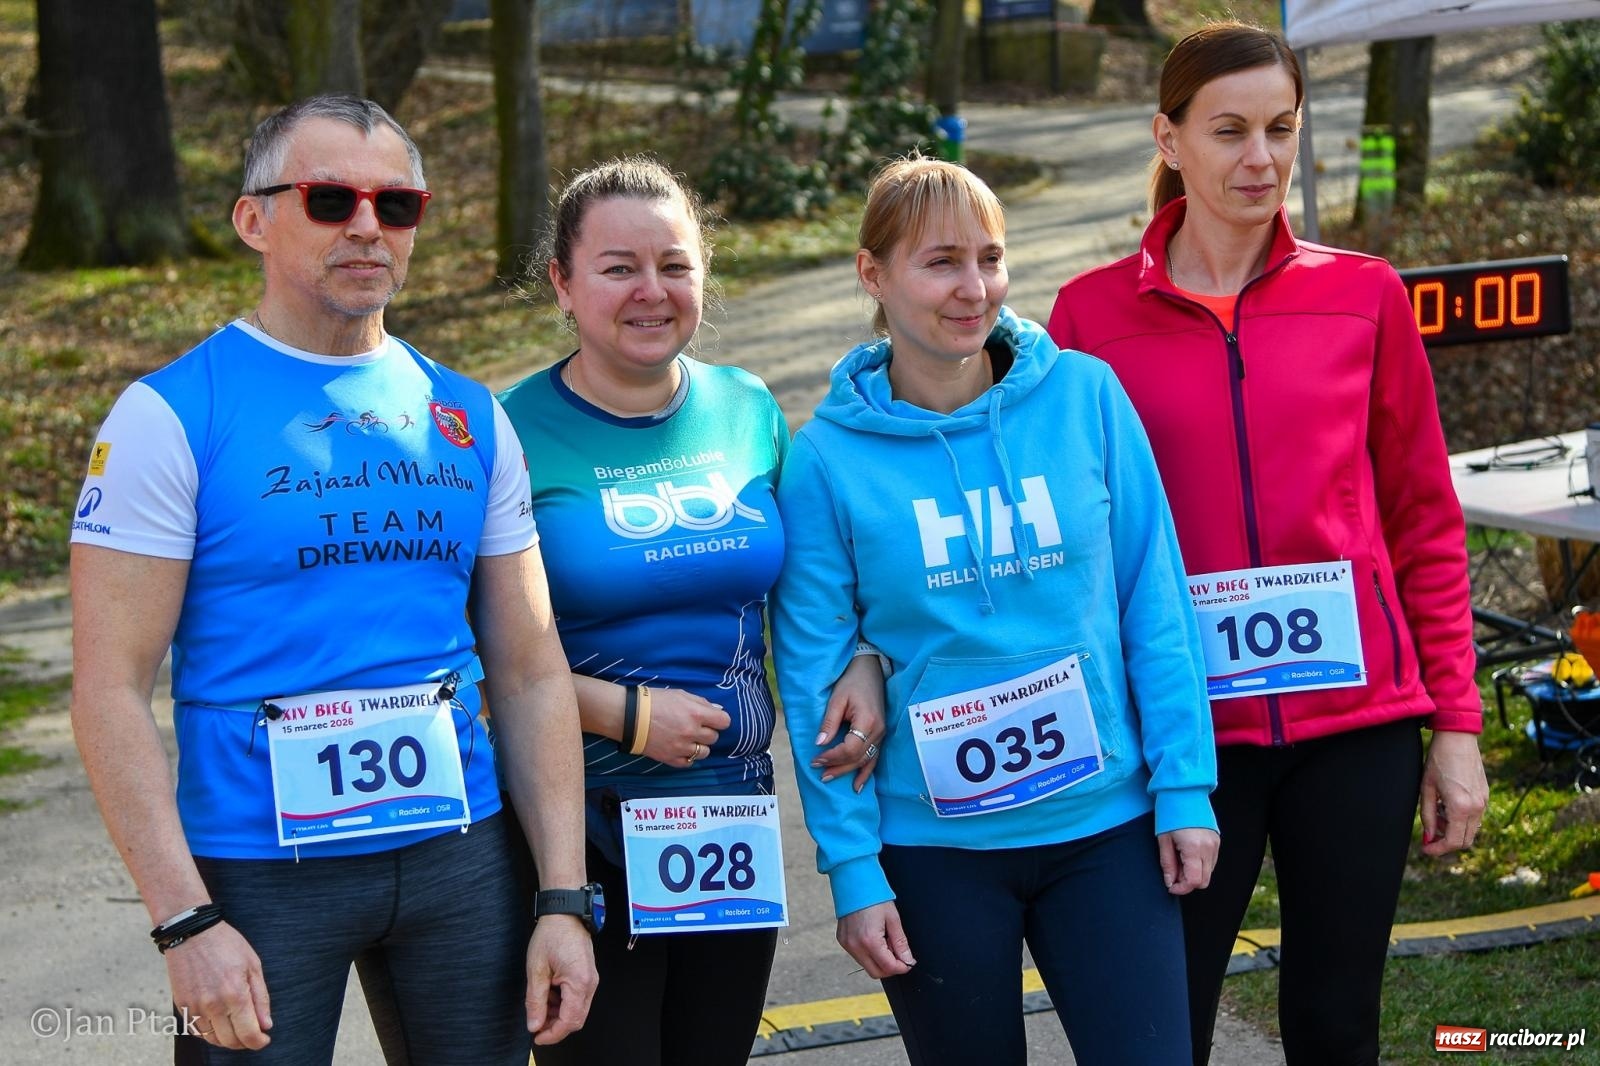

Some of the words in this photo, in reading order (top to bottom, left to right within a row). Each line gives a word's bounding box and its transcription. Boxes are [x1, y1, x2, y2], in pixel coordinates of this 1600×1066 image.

[261, 460, 371, 499] Zajazd
[378, 460, 475, 493] Malibu
[319, 510, 444, 537] TEAM
[297, 538, 463, 570] DREWNIAK
[644, 536, 750, 563] RACIBÓRZ
[1216, 578, 1249, 594] BIEG
[1254, 571, 1339, 589] TWARDZIELA
[1199, 597, 1228, 606] marzec
[1229, 593, 1250, 602] 2026
[1216, 608, 1323, 661] 108
[282, 704, 308, 721] XIV
[315, 700, 353, 718] BIEG
[359, 693, 440, 712] TWARDZIELA
[922, 708, 945, 725] XIV
[951, 699, 985, 718] BIEG
[989, 670, 1070, 708] TWARDZIELA
[282, 725, 293, 734] 15
[294, 722, 328, 732] marzec
[330, 718, 354, 728] 2026
[924, 727, 934, 736] 15
[935, 719, 965, 734] marzec
[966, 714, 988, 726] 2026
[956, 711, 1065, 783] 035
[317, 735, 427, 797] 130
[634, 807, 658, 821] XIV
[664, 806, 697, 819] BIEG
[702, 804, 768, 818] TWARDZIELA
[634, 824, 643, 832] 15
[645, 823, 675, 831] marzec
[677, 822, 697, 830] 2026
[658, 842, 756, 893] 028
